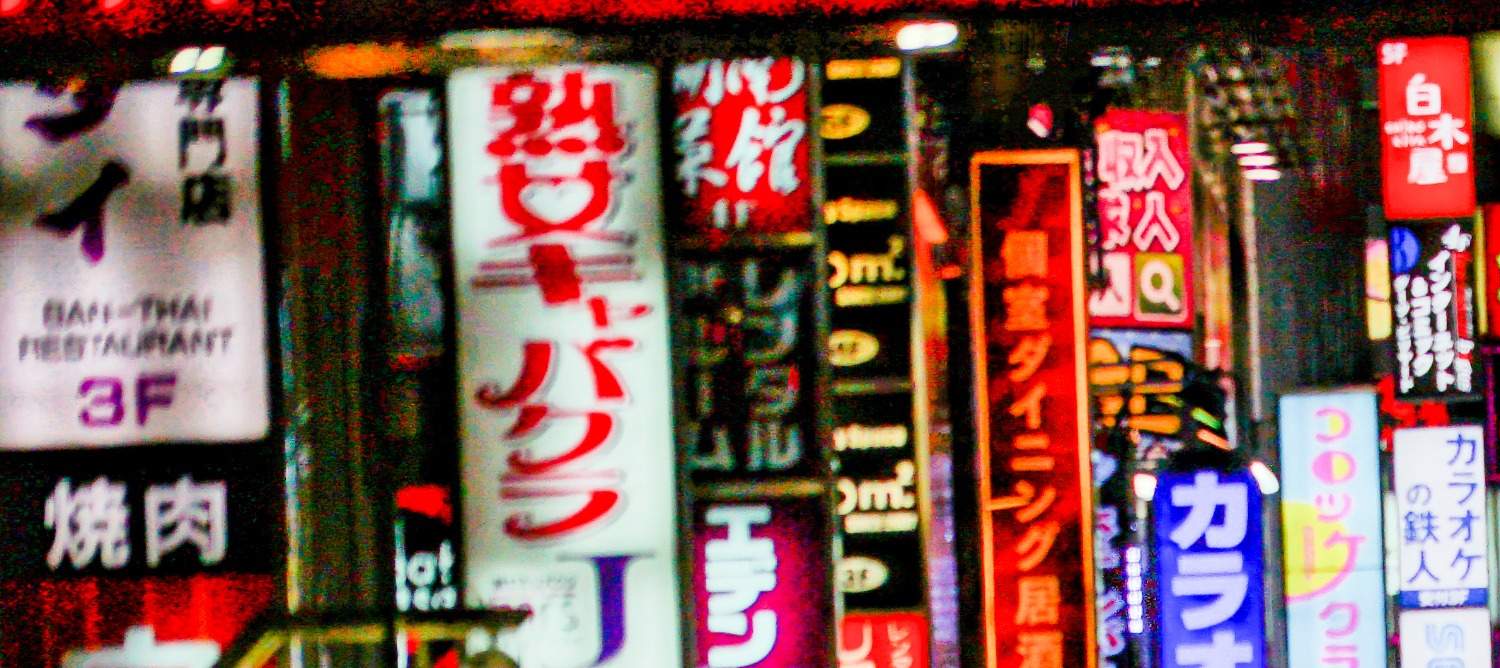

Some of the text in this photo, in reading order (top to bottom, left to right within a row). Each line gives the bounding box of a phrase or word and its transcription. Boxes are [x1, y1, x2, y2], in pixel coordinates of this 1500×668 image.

[77, 371, 178, 428] 3F
[43, 473, 230, 569] 焼肉
[1407, 483, 1441, 584] の鉄人
[1446, 433, 1483, 581] カラオケ
